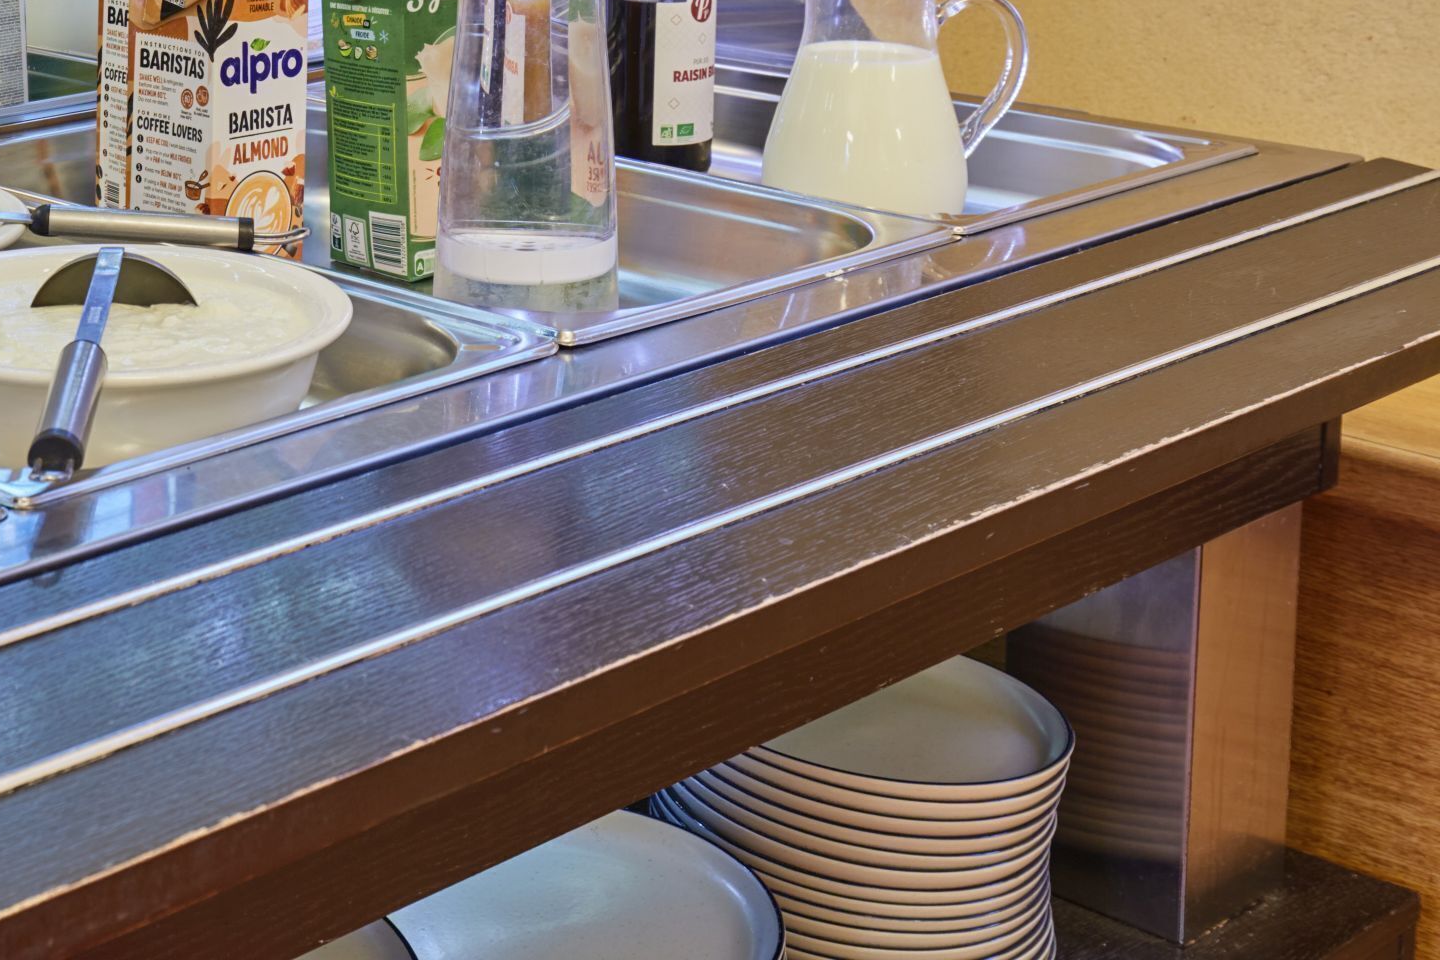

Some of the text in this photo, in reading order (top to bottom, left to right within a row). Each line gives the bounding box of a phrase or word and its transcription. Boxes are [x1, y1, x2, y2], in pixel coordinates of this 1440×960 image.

[140, 40, 192, 54] INSTRUCTIONS
[140, 48, 205, 79] BARISTAS
[219, 41, 303, 94] alpro
[673, 67, 707, 83] RAISIN
[136, 116, 203, 143] COFFEE LOVERS
[228, 103, 293, 134] BARISTA
[233, 135, 289, 166] ALMOND
